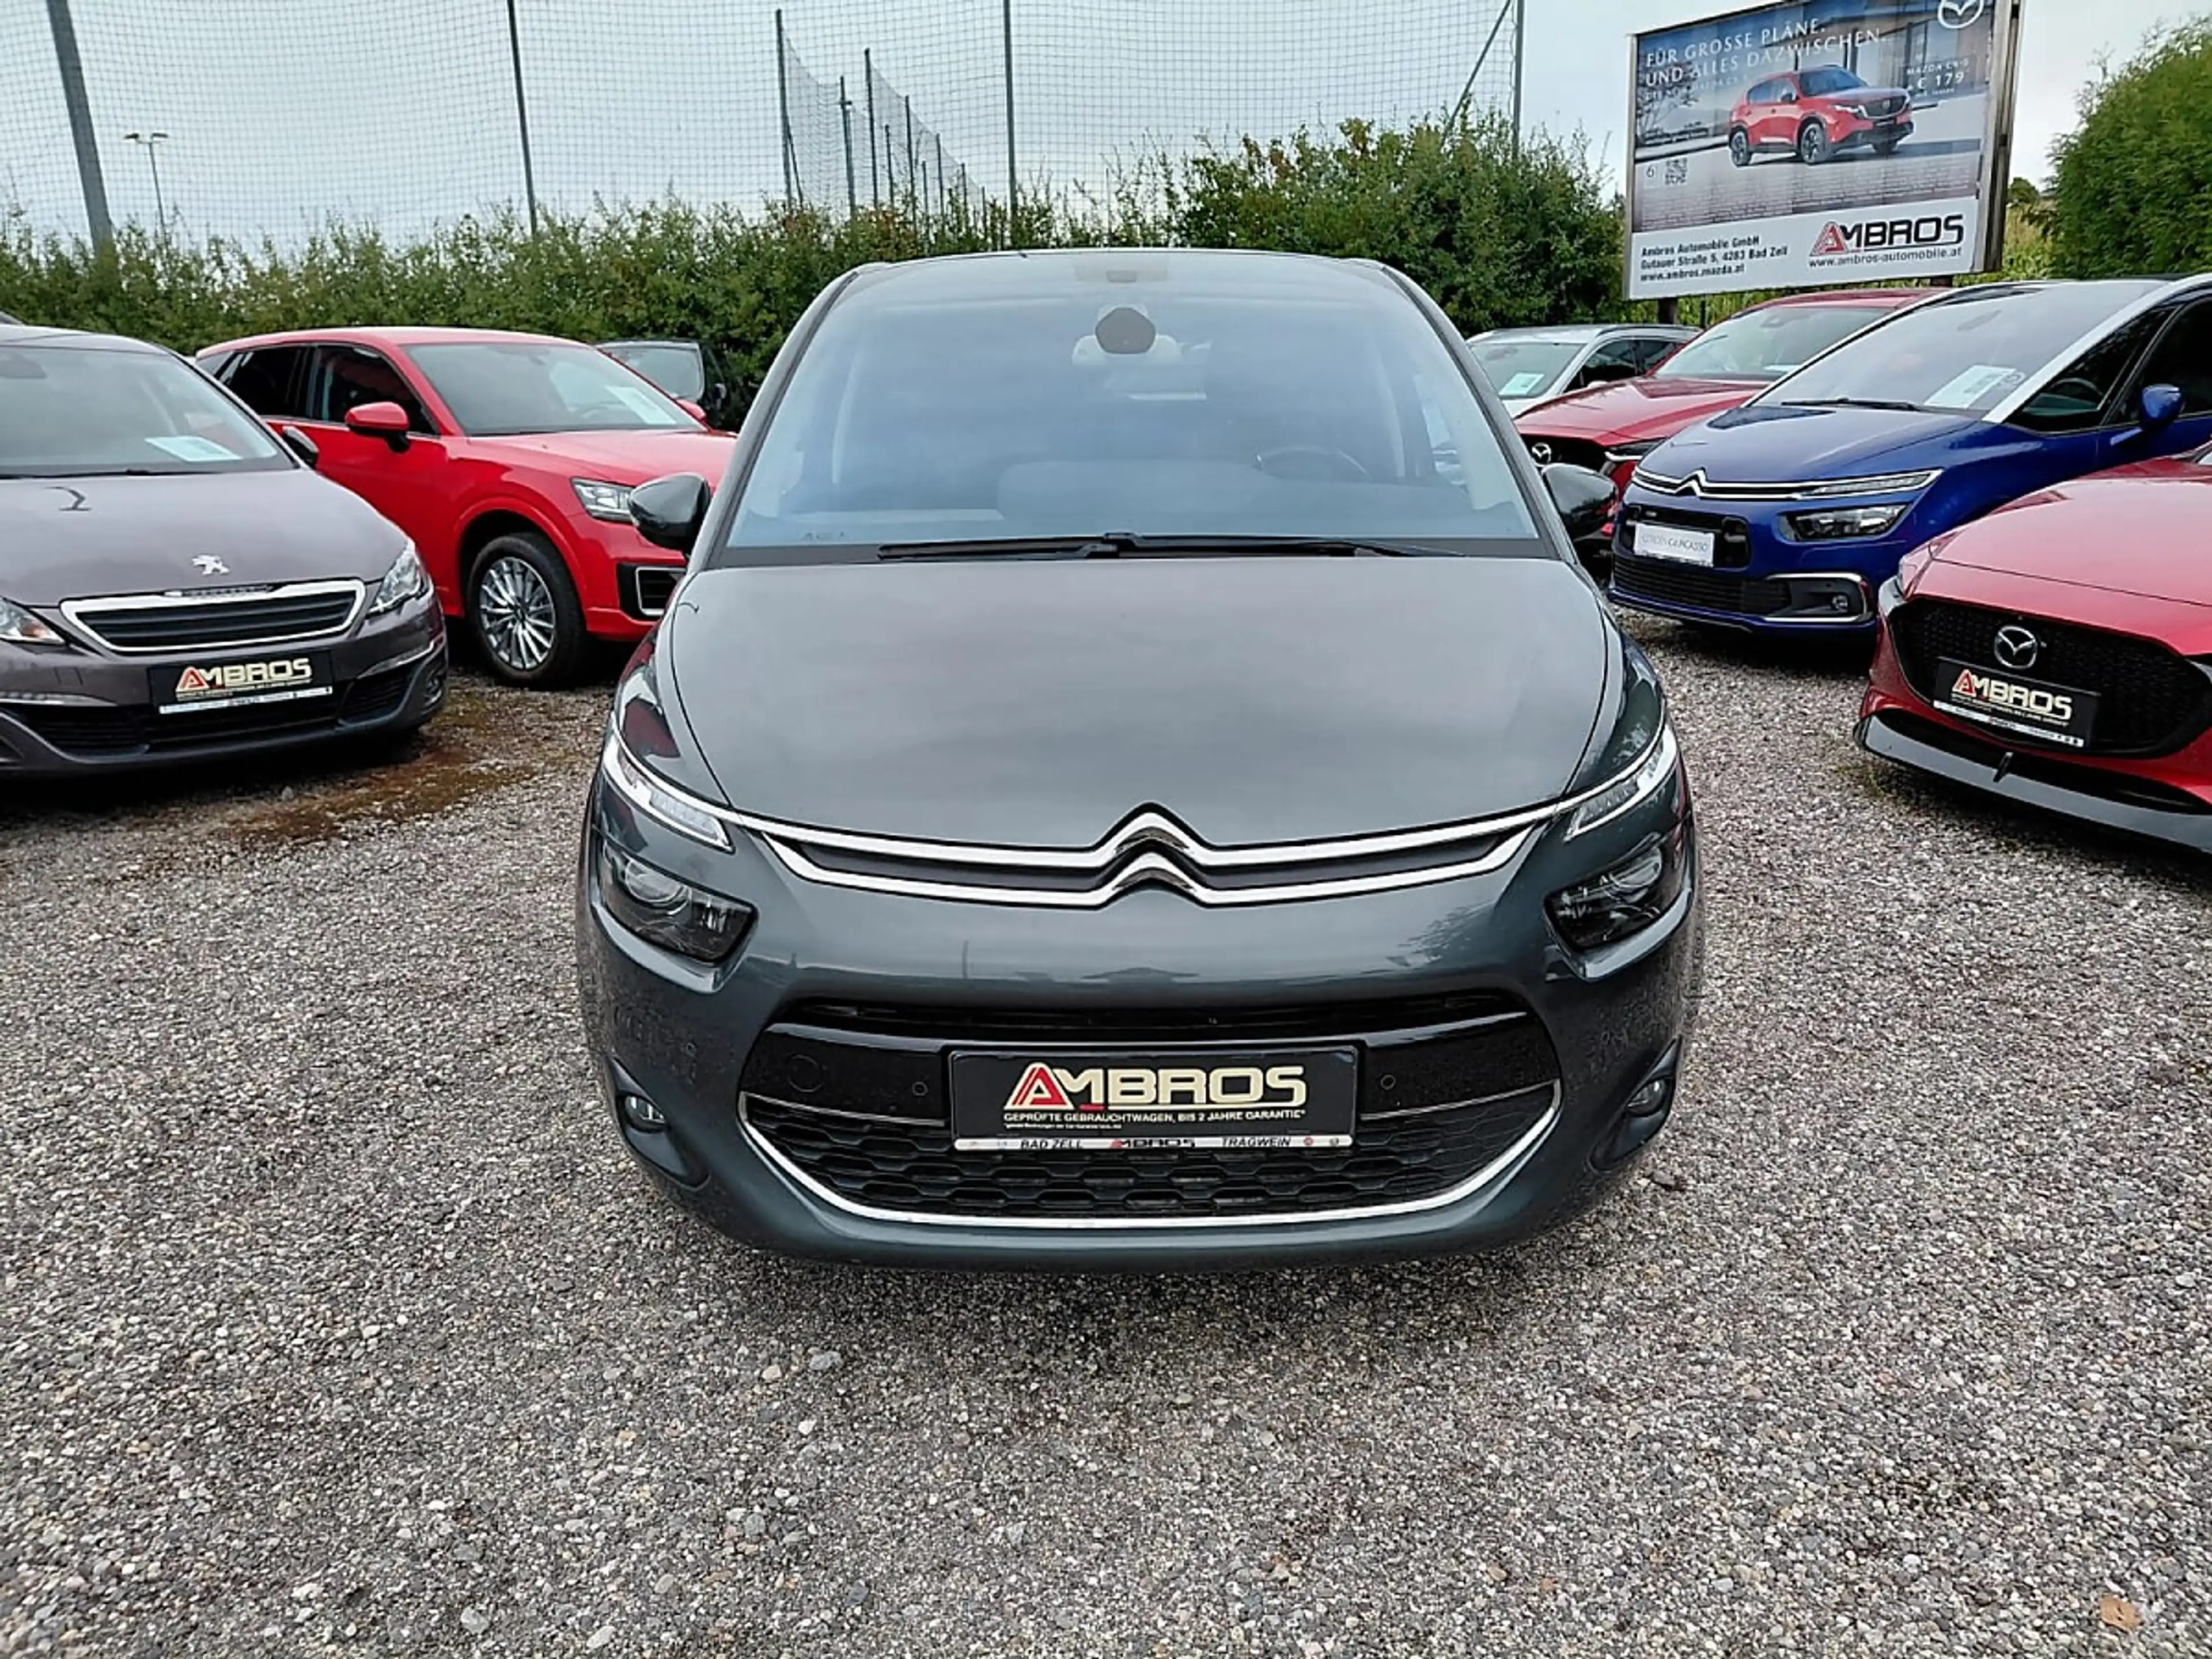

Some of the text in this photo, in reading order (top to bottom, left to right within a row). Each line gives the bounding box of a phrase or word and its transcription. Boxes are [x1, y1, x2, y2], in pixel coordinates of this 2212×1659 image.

[1646, 18, 1825, 67] FÜR GROSSE PLÄNE.
[1645, 67, 1683, 86] UND
[1690, 55, 1738, 78] ALLES
[1641, 235, 1759, 257] Ambros Automobile GmbH
[1808, 214, 1964, 257] AMBROS
[1677, 254, 1707, 266] Straße
[1748, 247, 1767, 259] Bad
[1769, 245, 1787, 257] Zell
[1808, 247, 1962, 268] www.ambros-automobile.at
[175, 657, 313, 692] AMBROS
[1952, 668, 2073, 721] AMBROS
[1002, 1062, 1307, 1111] AMBROS
[1003, 1111, 1062, 1123] GEPRÜFTE
[1063, 1112, 1176, 1123] GEBRAUCHTWAGEN,
[1177, 1113, 1196, 1122] BIS
[1198, 1112, 1206, 1121] 2
[1207, 1111, 1244, 1121] JAHRE
[1020, 1139, 1048, 1150] BAD
[1050, 1138, 1083, 1150] ZELL
[1221, 1136, 1291, 1147] TRAGWEIN
